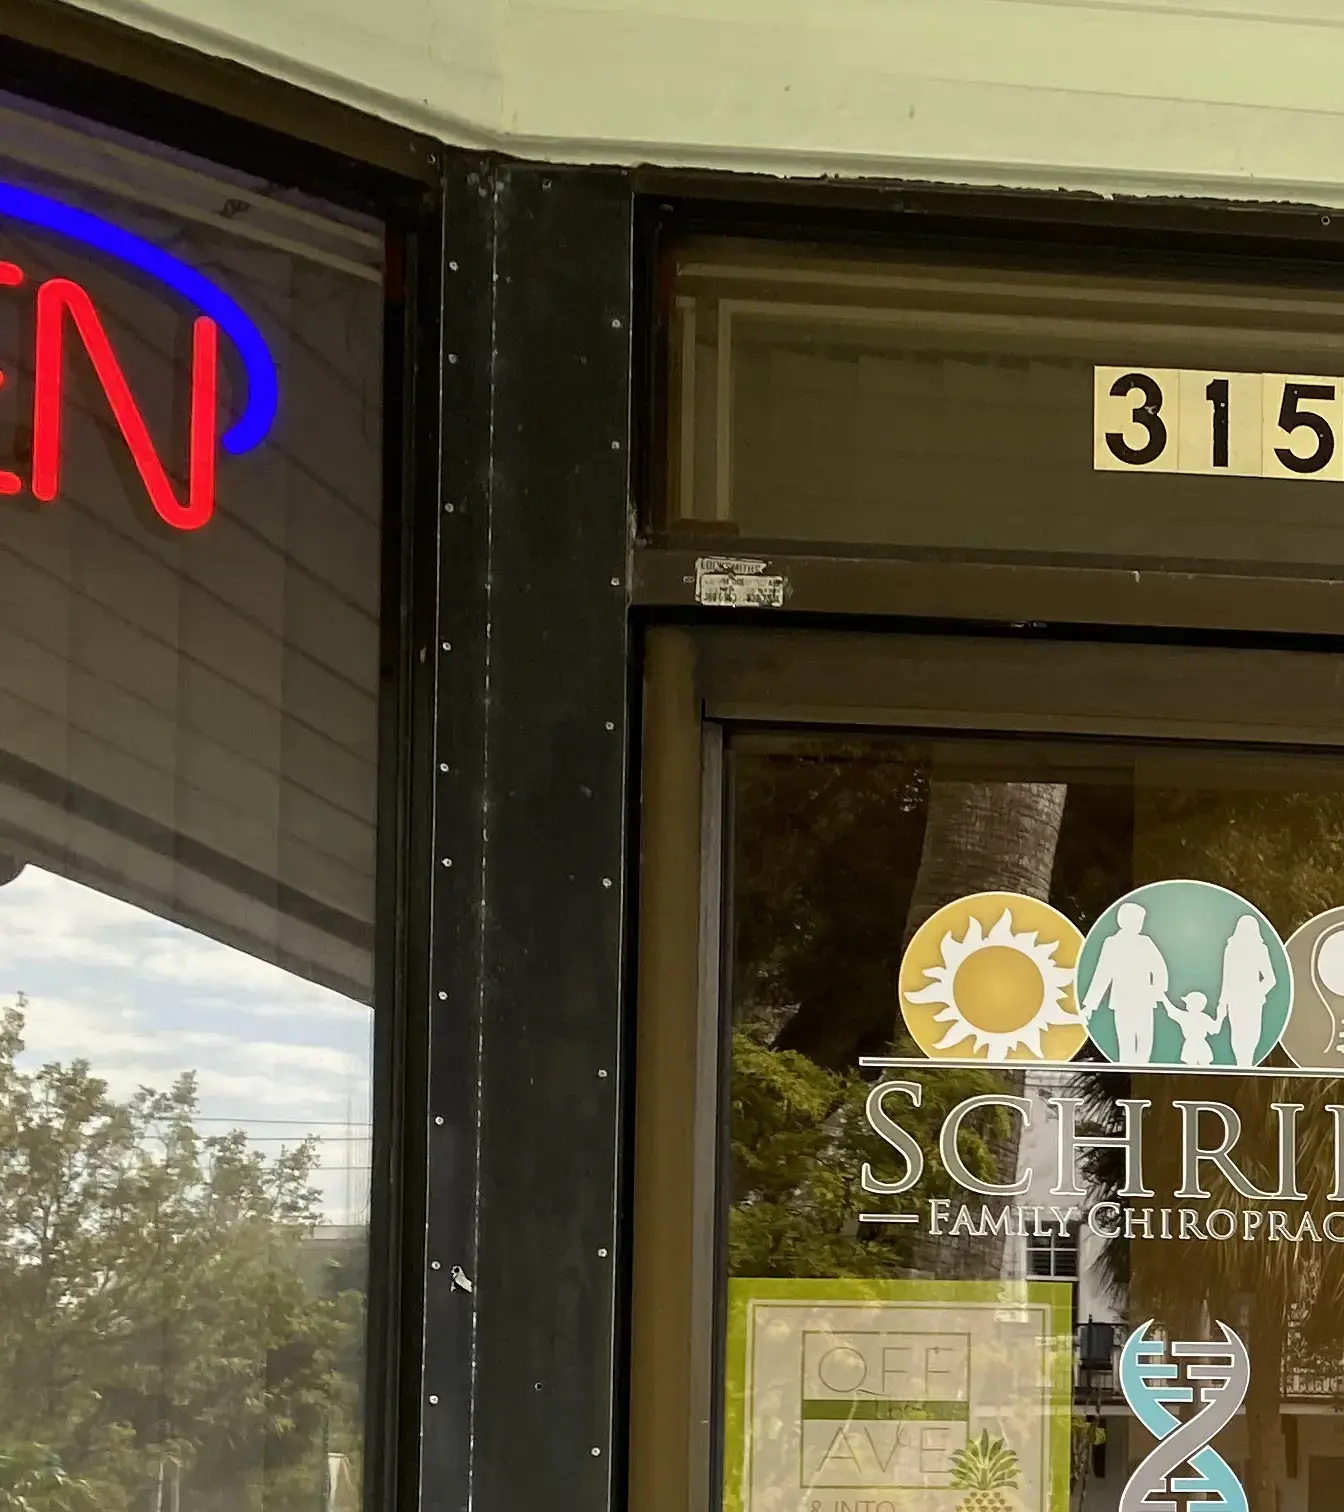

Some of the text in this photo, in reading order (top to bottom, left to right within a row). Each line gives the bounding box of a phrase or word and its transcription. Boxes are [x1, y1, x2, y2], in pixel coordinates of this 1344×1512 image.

[1105, 373, 1336, 473] 315
[928, 1200, 1079, 1240] FAMILY
[816, 1426, 952, 1474] AVE
